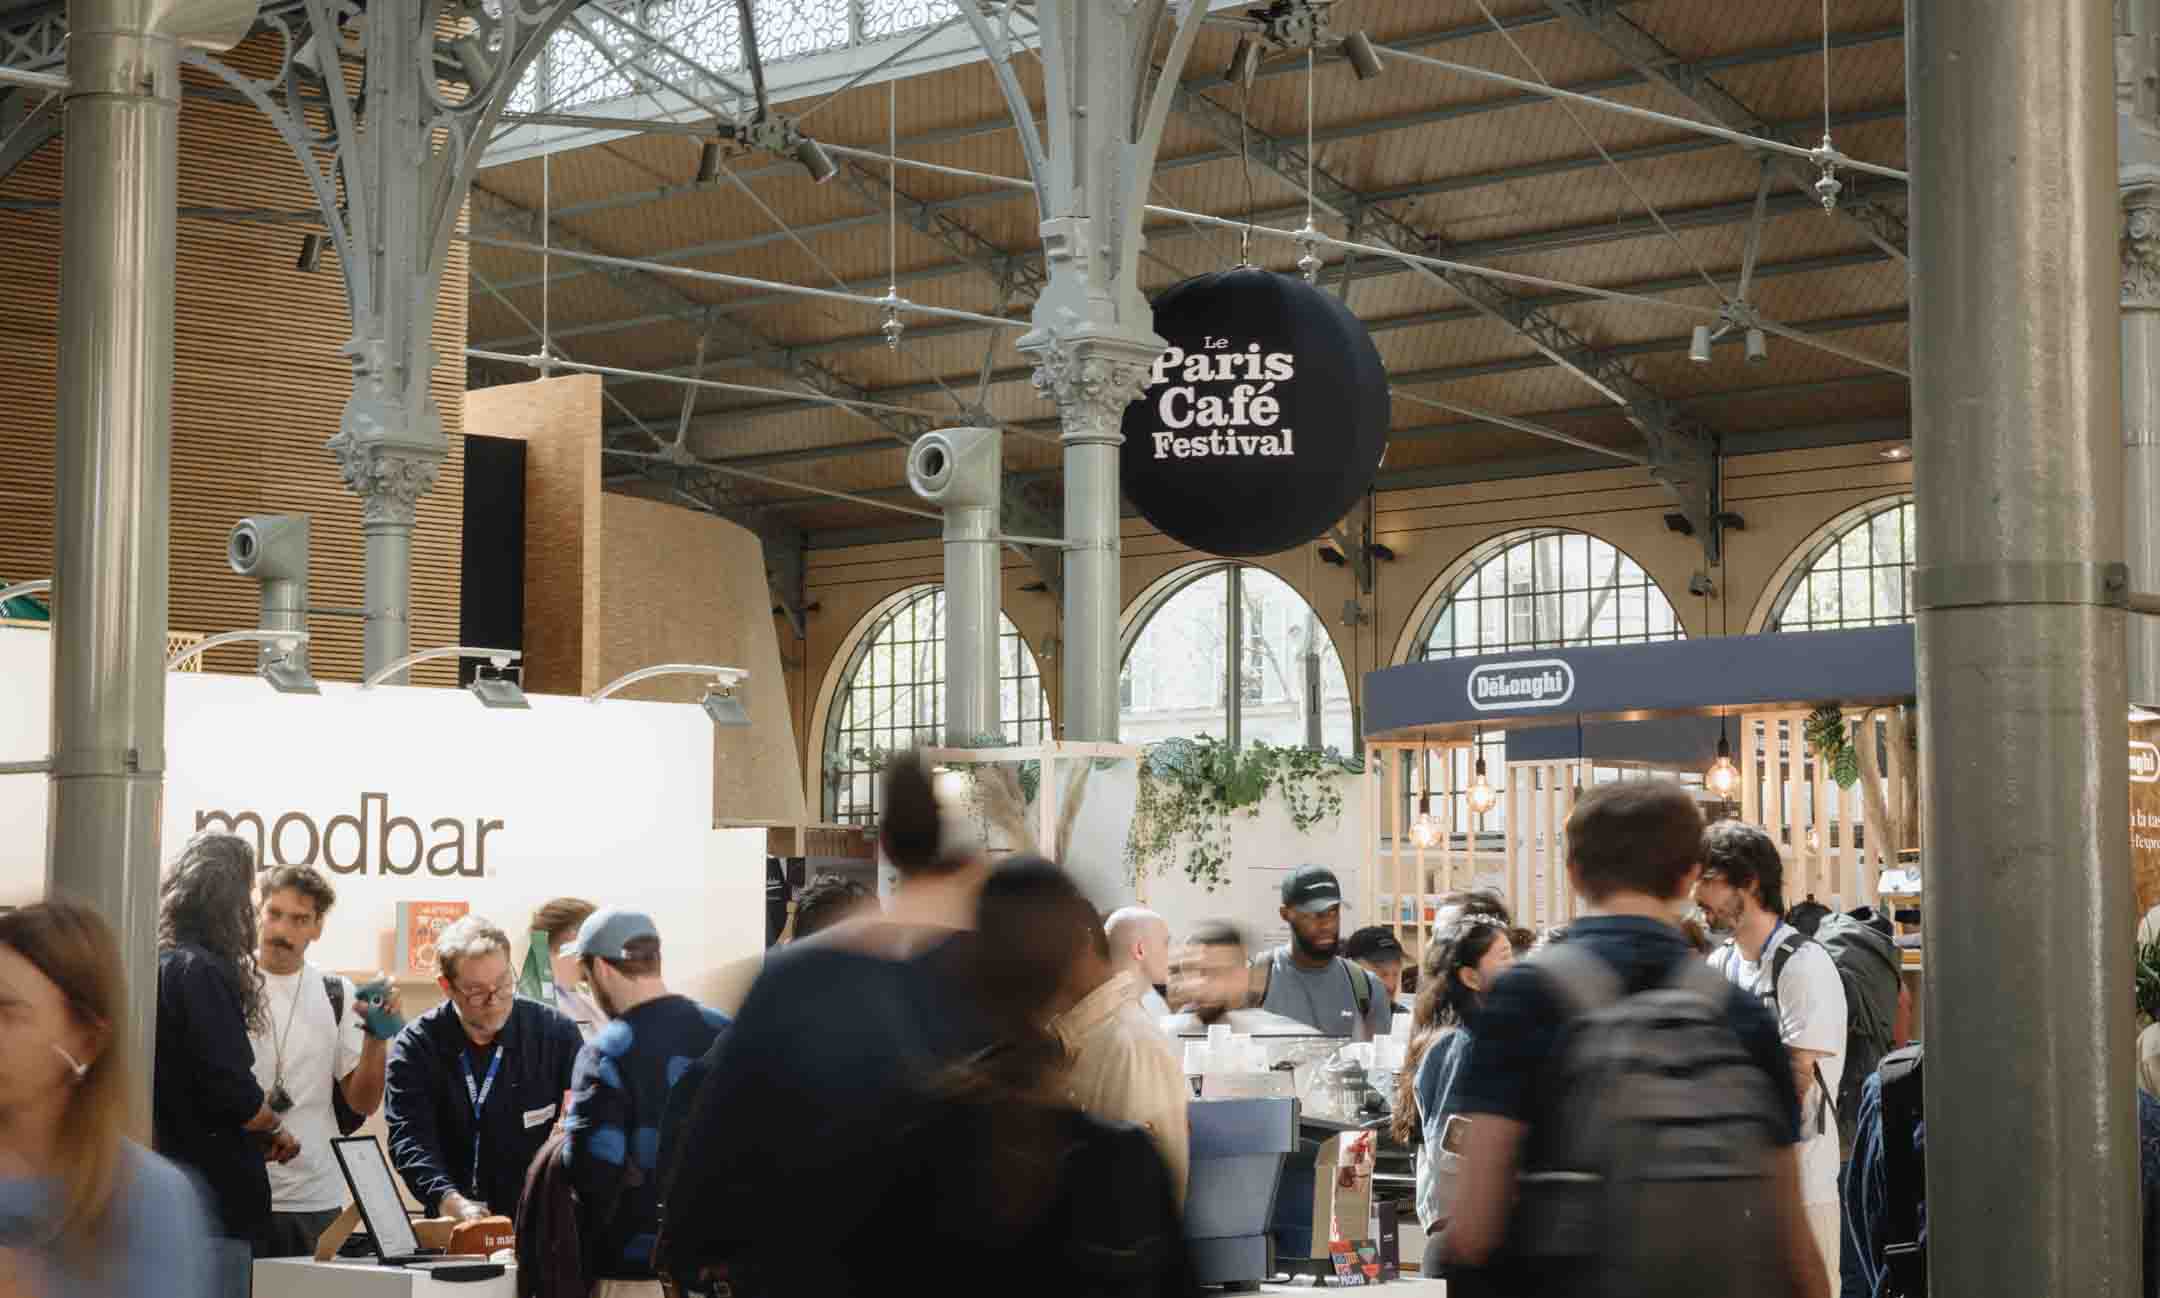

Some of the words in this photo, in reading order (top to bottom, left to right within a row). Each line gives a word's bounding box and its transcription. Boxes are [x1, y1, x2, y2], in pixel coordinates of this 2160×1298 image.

[1204, 336, 1229, 349] Le
[1152, 343, 1294, 384] Paris
[1159, 382, 1281, 429] Café
[1152, 429, 1294, 459] Festival
[196, 791, 505, 878] modbar
